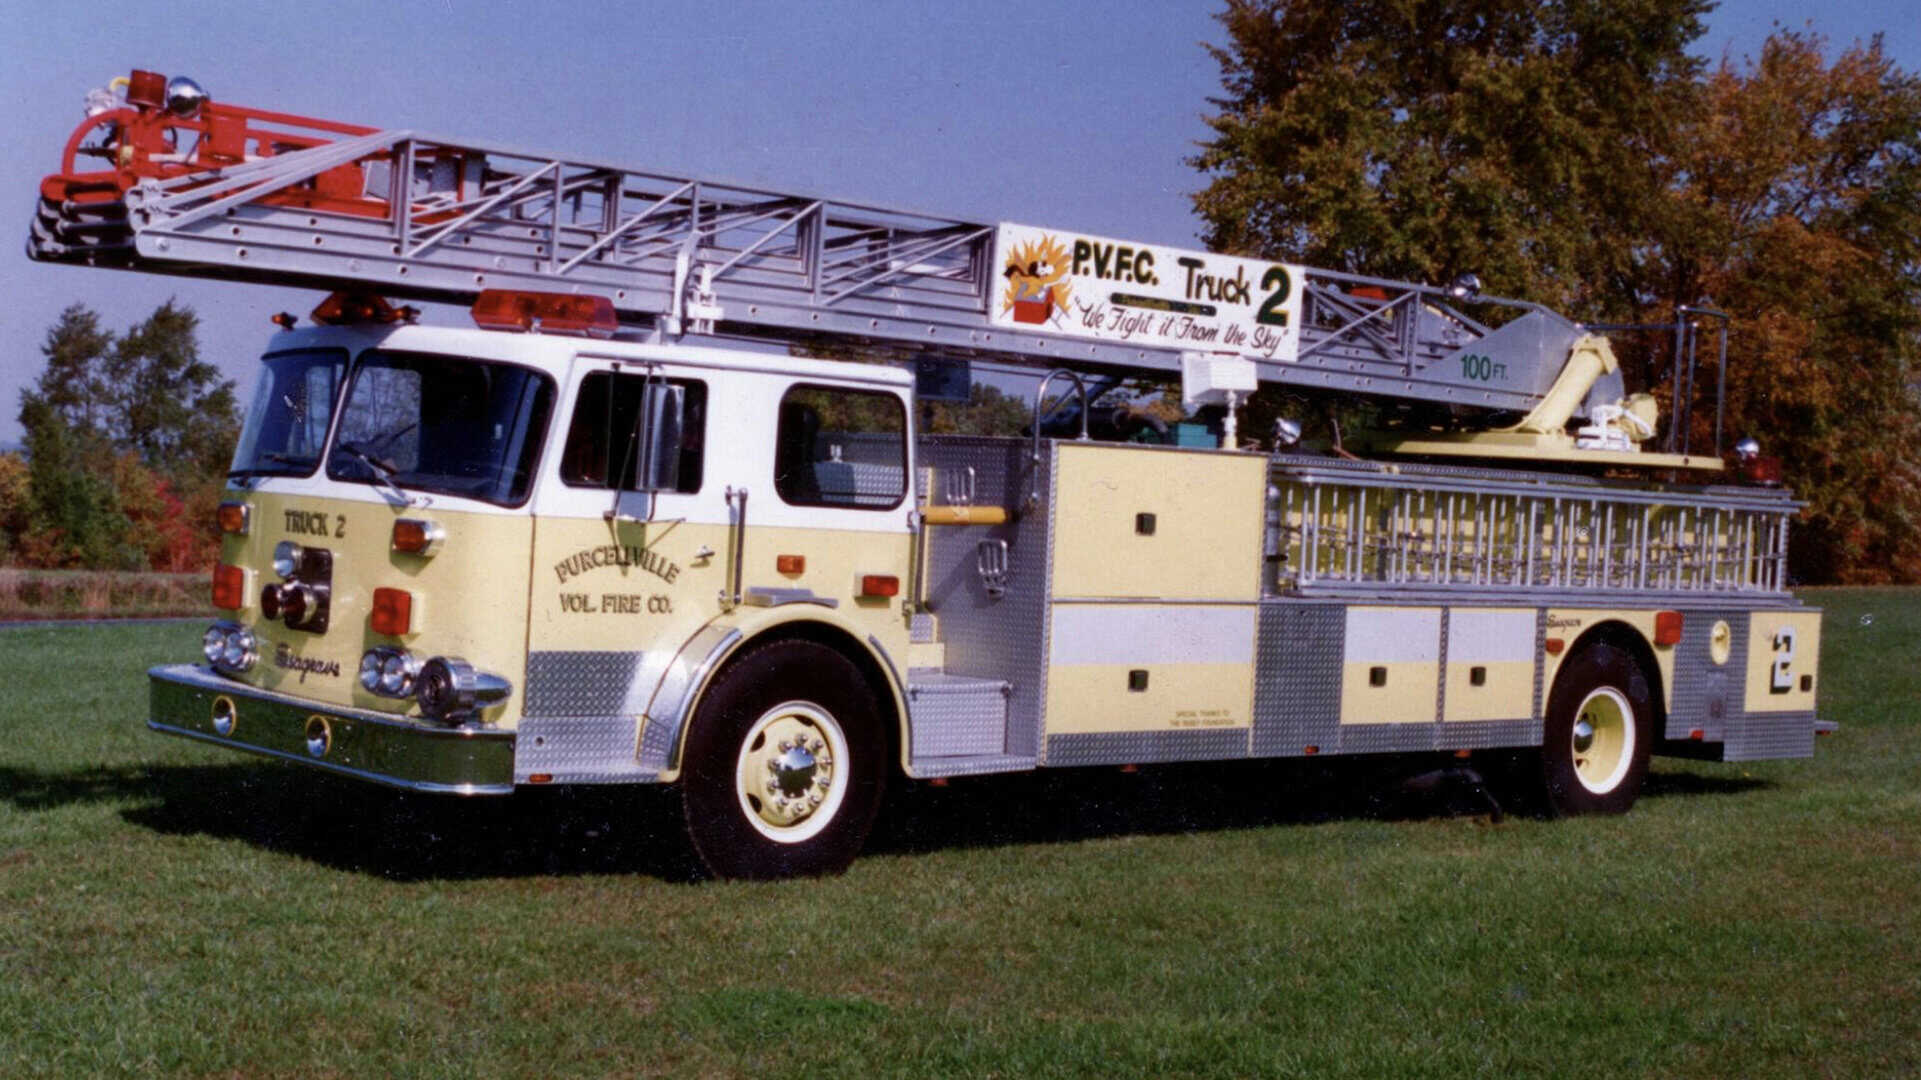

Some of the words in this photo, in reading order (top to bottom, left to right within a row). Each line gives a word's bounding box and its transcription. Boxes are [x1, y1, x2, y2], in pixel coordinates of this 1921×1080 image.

[1072, 238, 1159, 286] P.V.F.C.
[1178, 256, 1251, 306] Truck
[1256, 264, 1291, 327] 2
[1107, 306, 1155, 340] Fight
[1158, 315, 1175, 337] it
[1175, 315, 1219, 342] From
[1224, 322, 1247, 346] the
[1461, 354, 1491, 381] 100
[284, 509, 328, 537] TRUCK
[335, 514, 347, 539] 2
[554, 544, 680, 585] PURCELLVILLE
[601, 594, 641, 614] FIRE
[647, 594, 673, 614] CO.
[1769, 626, 1797, 695] 2
